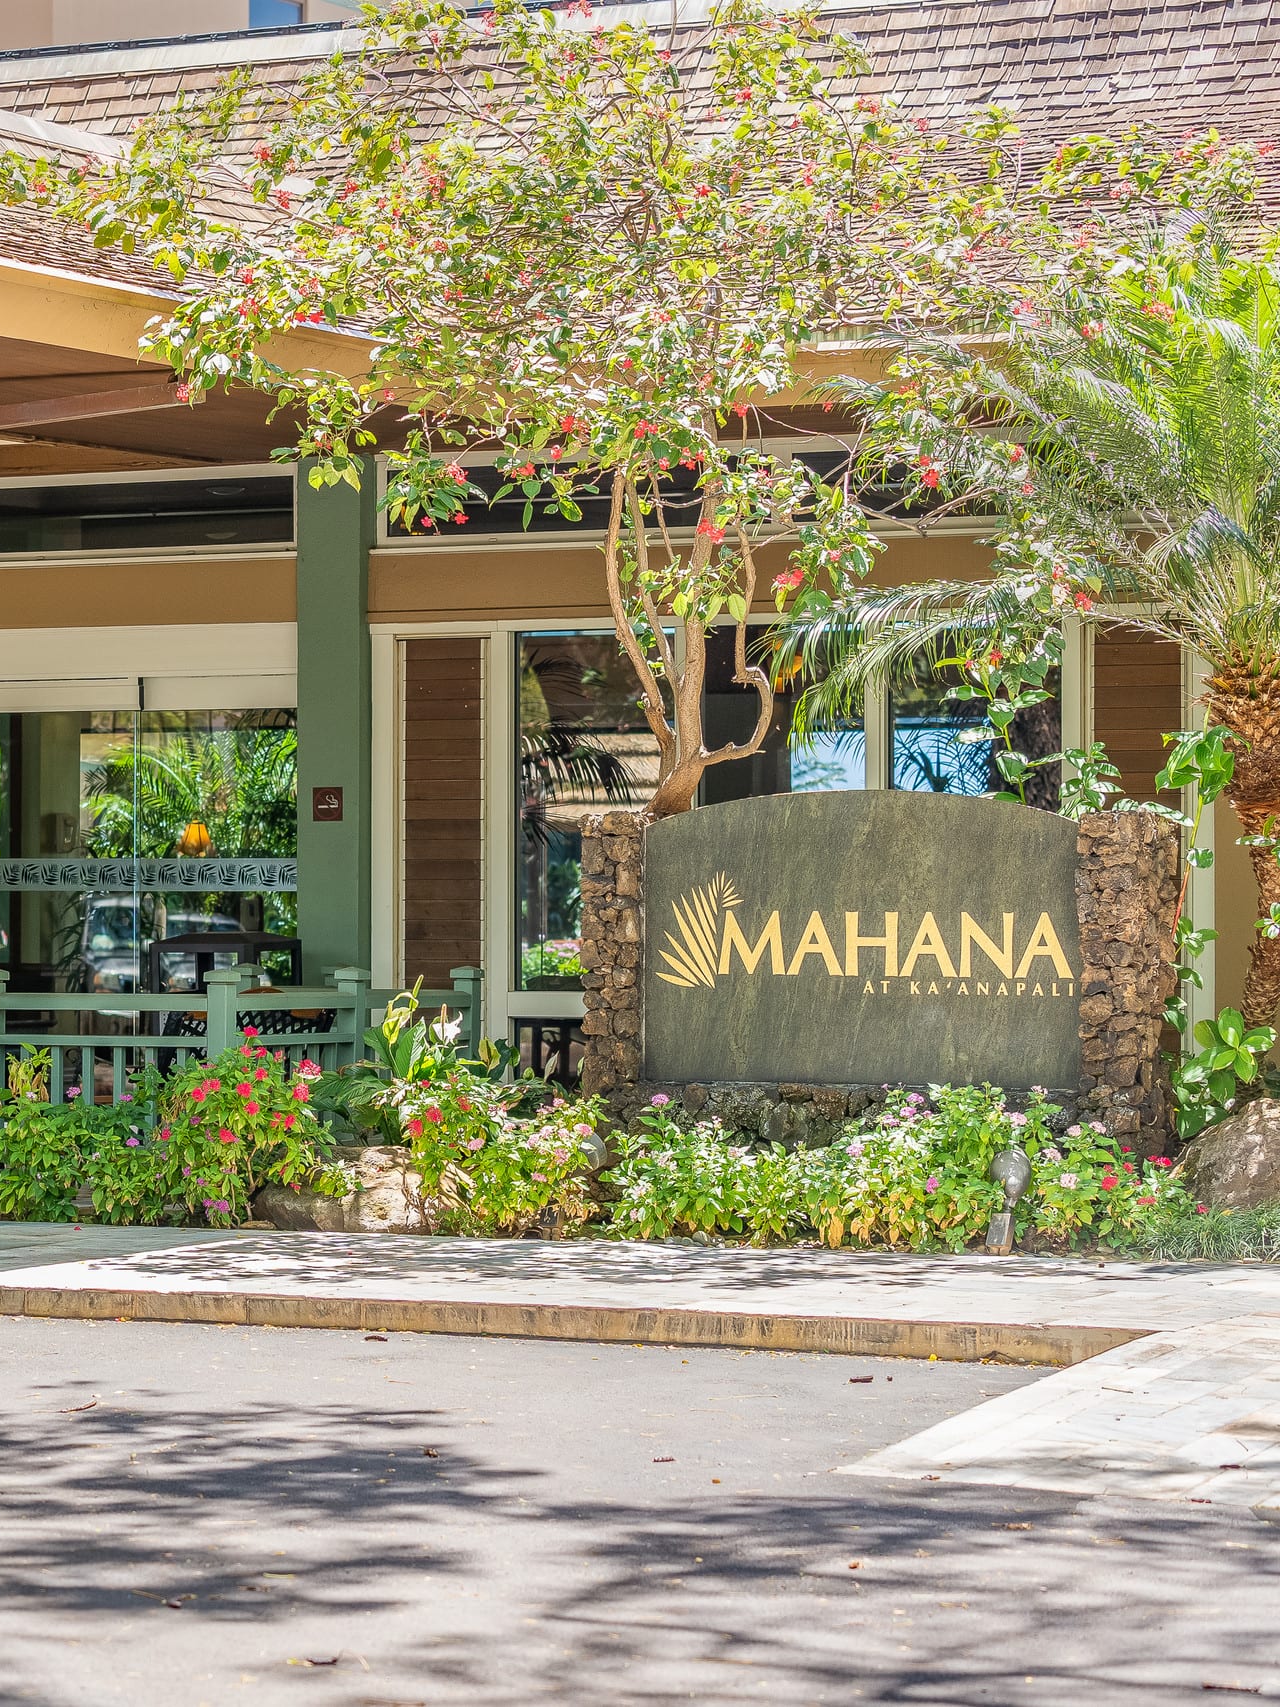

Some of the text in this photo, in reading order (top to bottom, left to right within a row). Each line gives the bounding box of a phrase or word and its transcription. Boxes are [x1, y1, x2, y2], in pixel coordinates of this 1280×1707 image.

[717, 911, 1075, 979] MAHANA
[863, 981, 1075, 997] AT KA'ANAPALI
